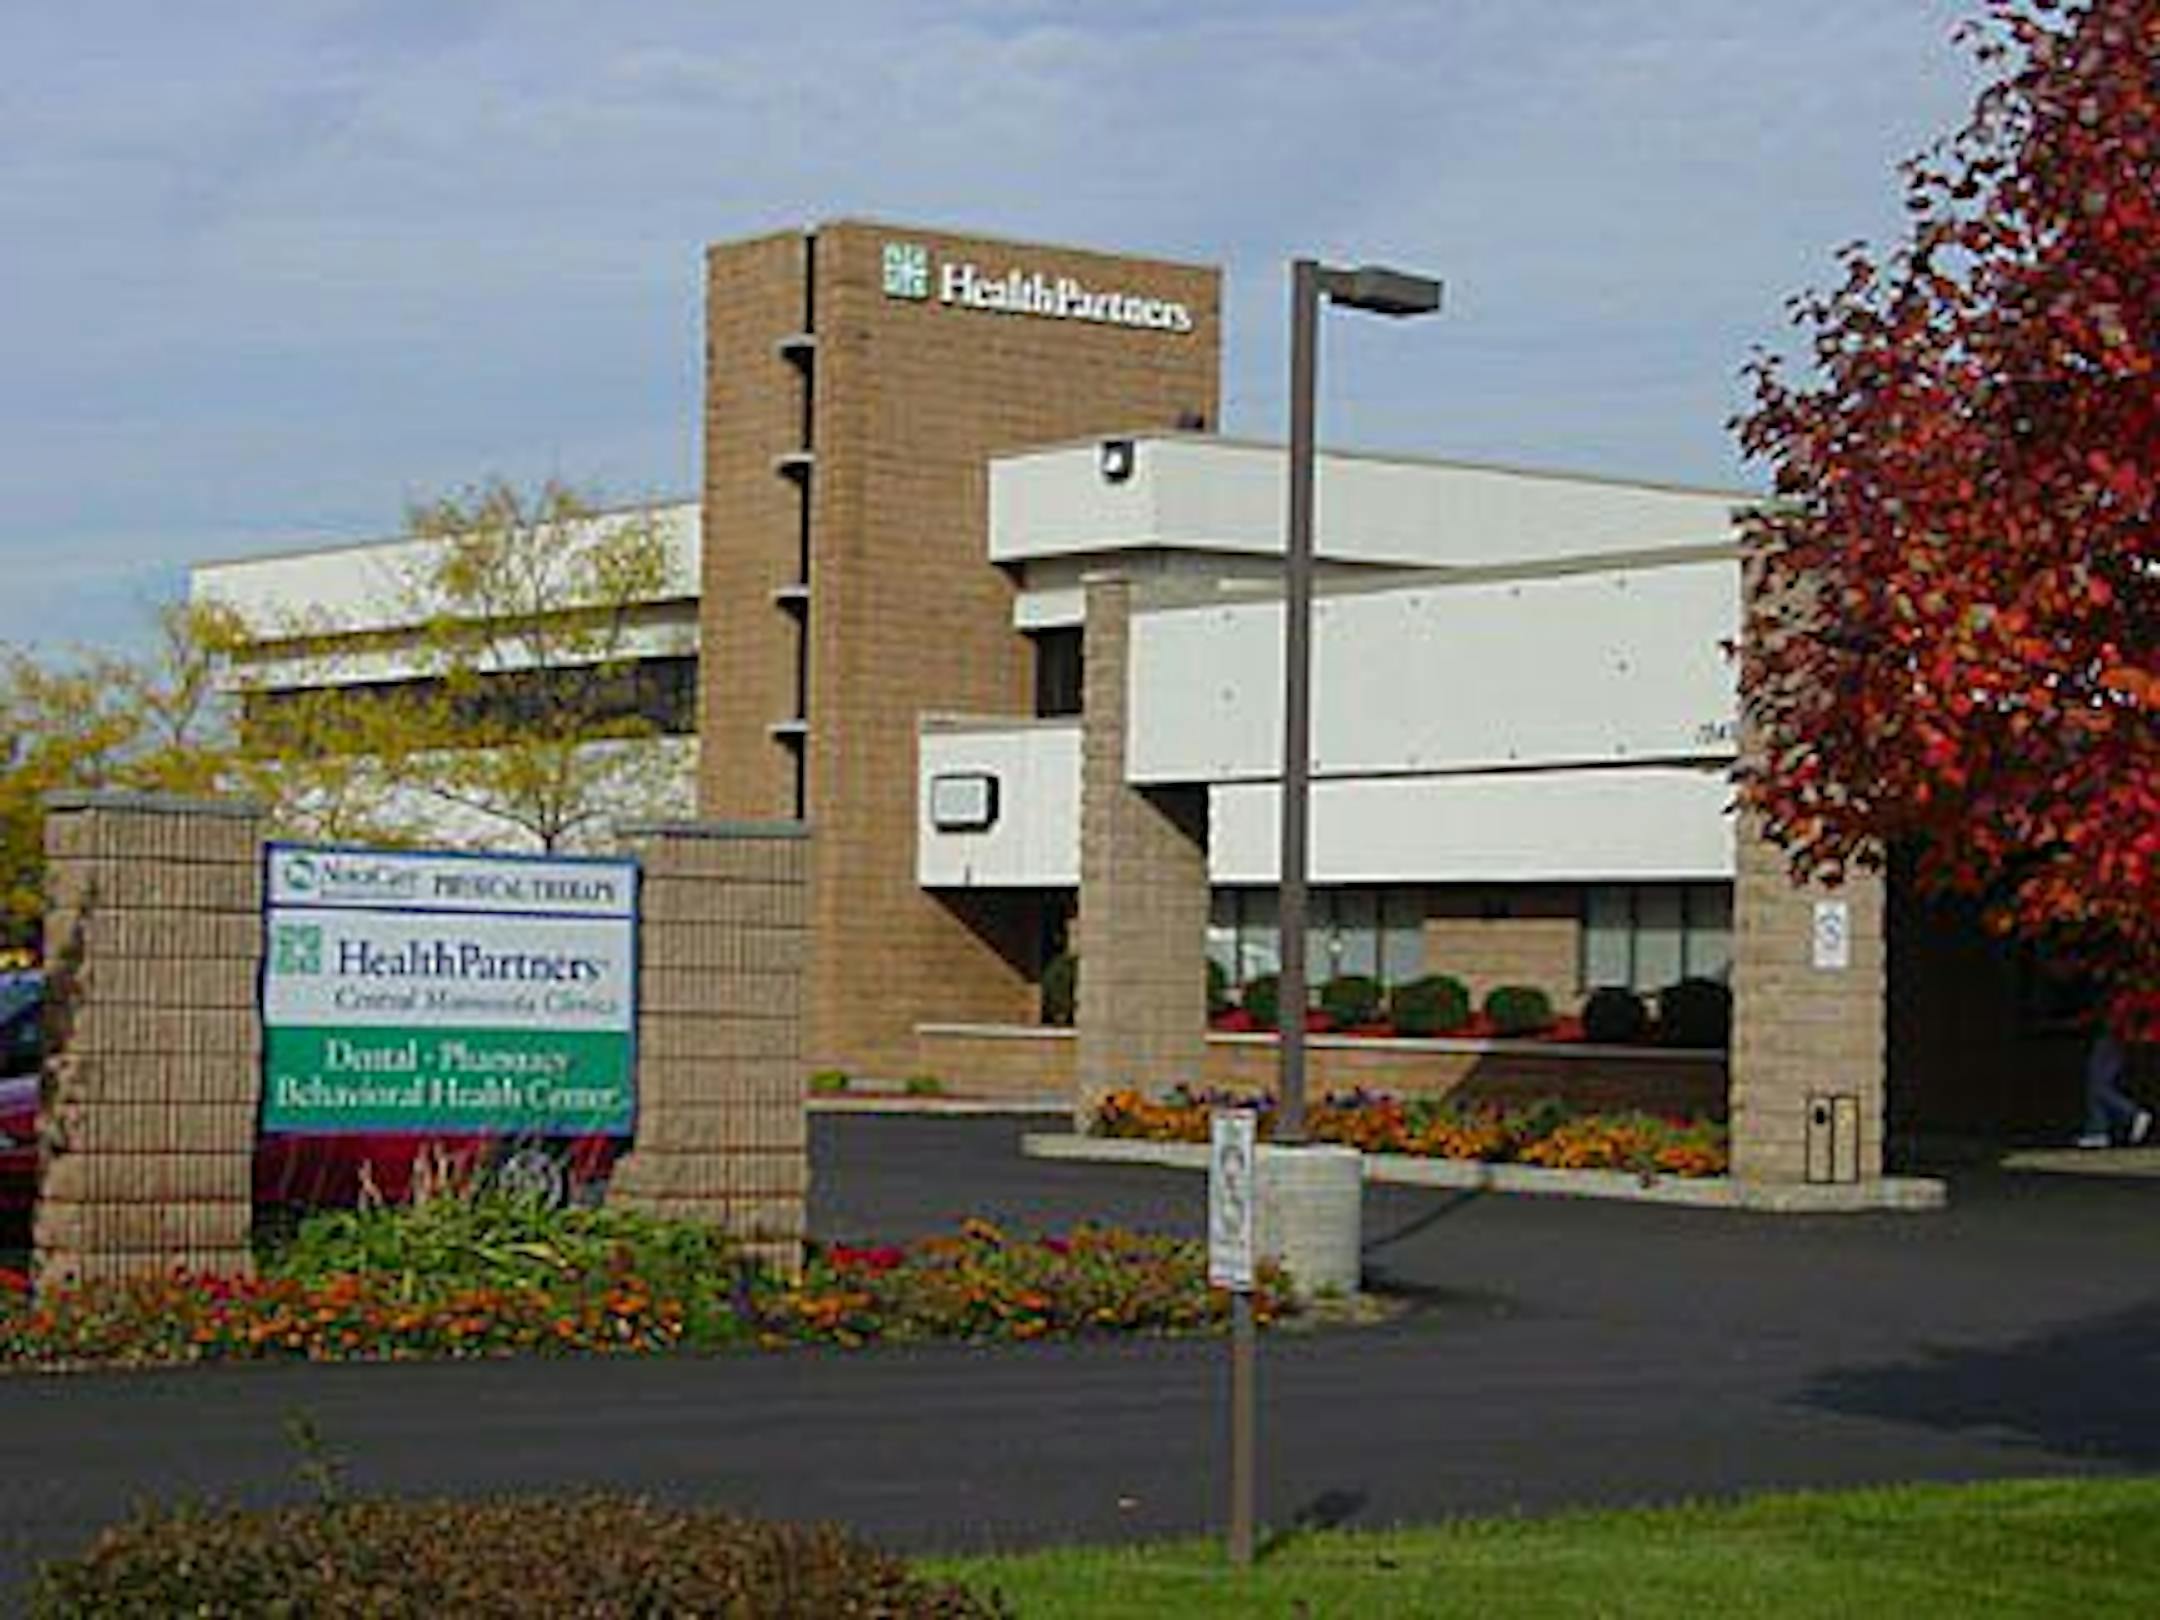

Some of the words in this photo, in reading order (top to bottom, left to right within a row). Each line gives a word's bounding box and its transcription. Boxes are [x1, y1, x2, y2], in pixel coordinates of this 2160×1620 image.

[940, 262, 1193, 332] HealthPartners
[338, 939, 603, 981] HealthPartners
[335, 985, 414, 1011] Central
[325, 1037, 418, 1072] Dental
[438, 1040, 569, 1079] Pharmacy
[277, 1073, 424, 1108] Behavioral
[428, 1076, 524, 1109] Health
